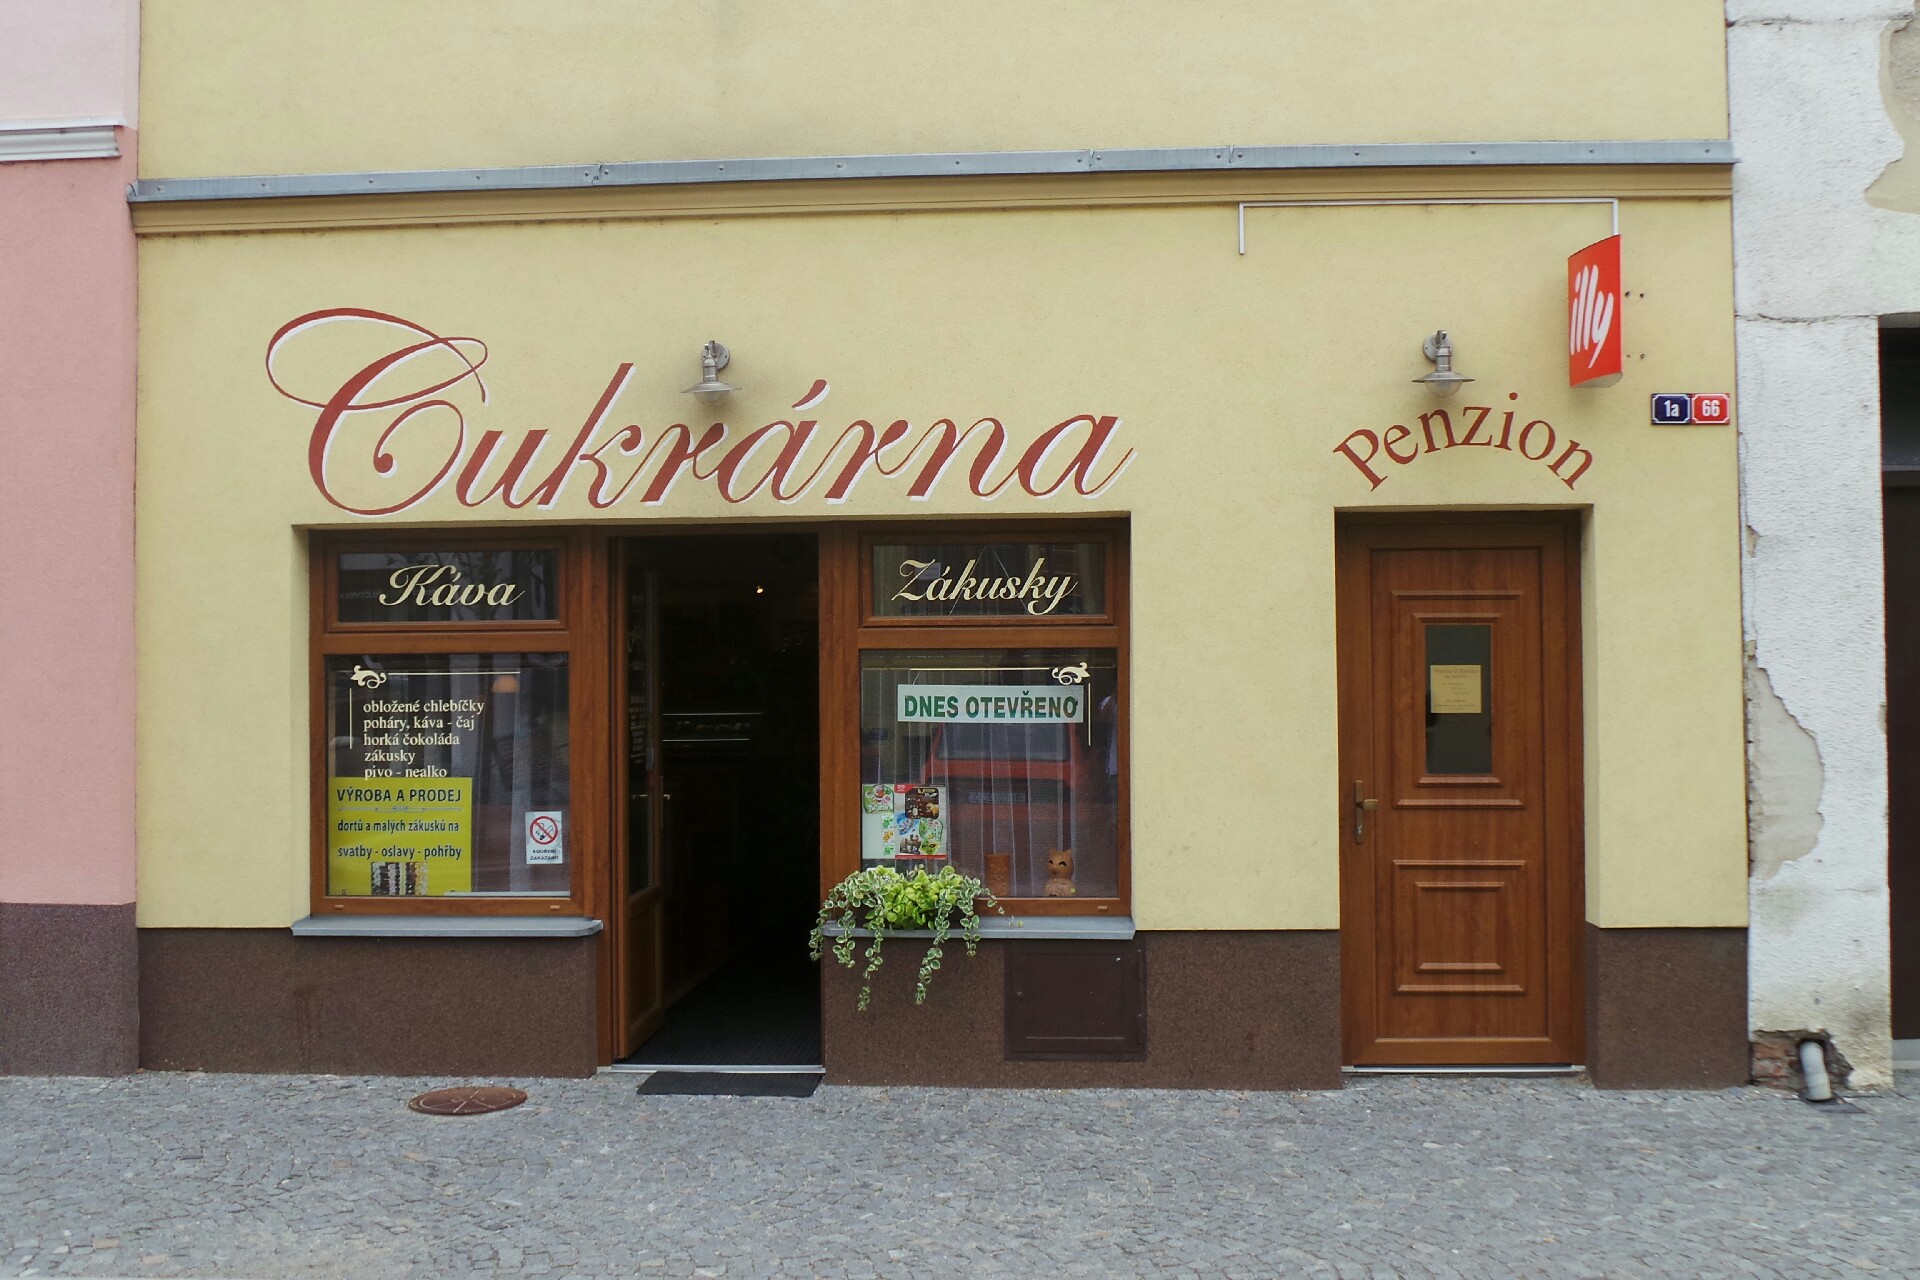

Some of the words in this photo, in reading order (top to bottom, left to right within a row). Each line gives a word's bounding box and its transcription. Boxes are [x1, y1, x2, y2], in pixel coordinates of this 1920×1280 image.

[1570, 264, 1614, 368] illy
[266, 307, 1137, 516] Cukrárna
[1664, 400, 1679, 417] 1a
[1702, 400, 1720, 417] 66
[1333, 392, 1593, 492] Penzion
[379, 565, 525, 606] Káva
[891, 557, 1079, 616] Zákusky
[363, 700, 420, 712] obložené
[424, 700, 485, 715] chlebíčky
[905, 695, 959, 717] DNES
[966, 691, 1077, 718] OTEVŘENO
[363, 717, 410, 732] poháry,
[413, 716, 443, 728] káva
[456, 715, 475, 731] čaj
[363, 733, 399, 745] horká
[403, 733, 460, 745] čokoláda
[364, 750, 415, 764] zákusky
[364, 766, 393, 780] pivo
[405, 766, 447, 778] nealko
[337, 787, 391, 802] VÝROBA
[396, 789, 405, 801] A
[410, 789, 461, 802] PRODEJ
[338, 819, 363, 831] dortů
[365, 822, 371, 831] a
[374, 819, 405, 836] malých
[408, 818, 446, 831] zákusků
[448, 822, 459, 831] na
[338, 845, 372, 860] svatby
[381, 845, 415, 860] oslavy
[424, 845, 461, 860] pohřby
